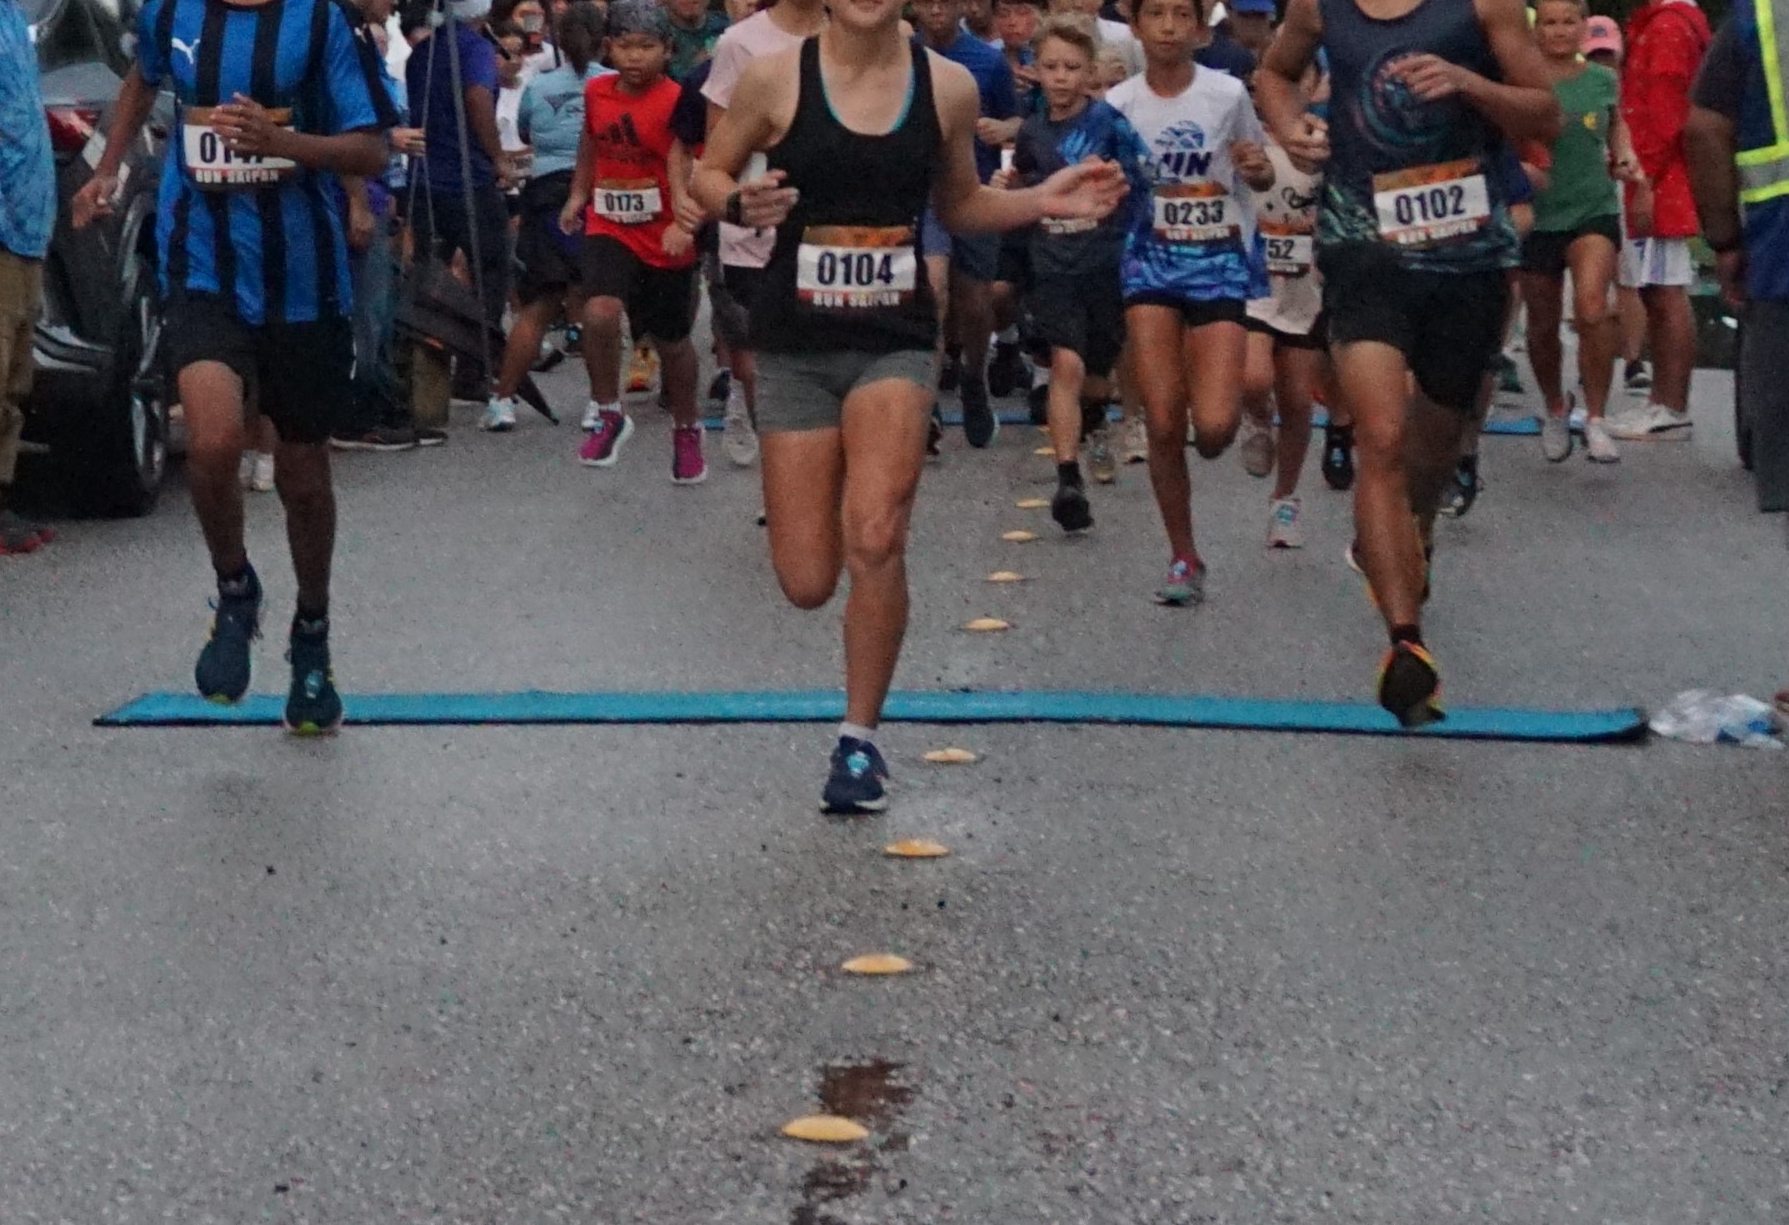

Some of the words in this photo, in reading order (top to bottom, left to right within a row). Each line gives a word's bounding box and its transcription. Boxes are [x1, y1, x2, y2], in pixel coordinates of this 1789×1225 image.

[605, 192, 644, 212] 0173
[1164, 200, 1224, 226] 0233
[1396, 185, 1466, 226] 0102
[1268, 239, 1295, 260] 52
[817, 251, 895, 286] 0104
